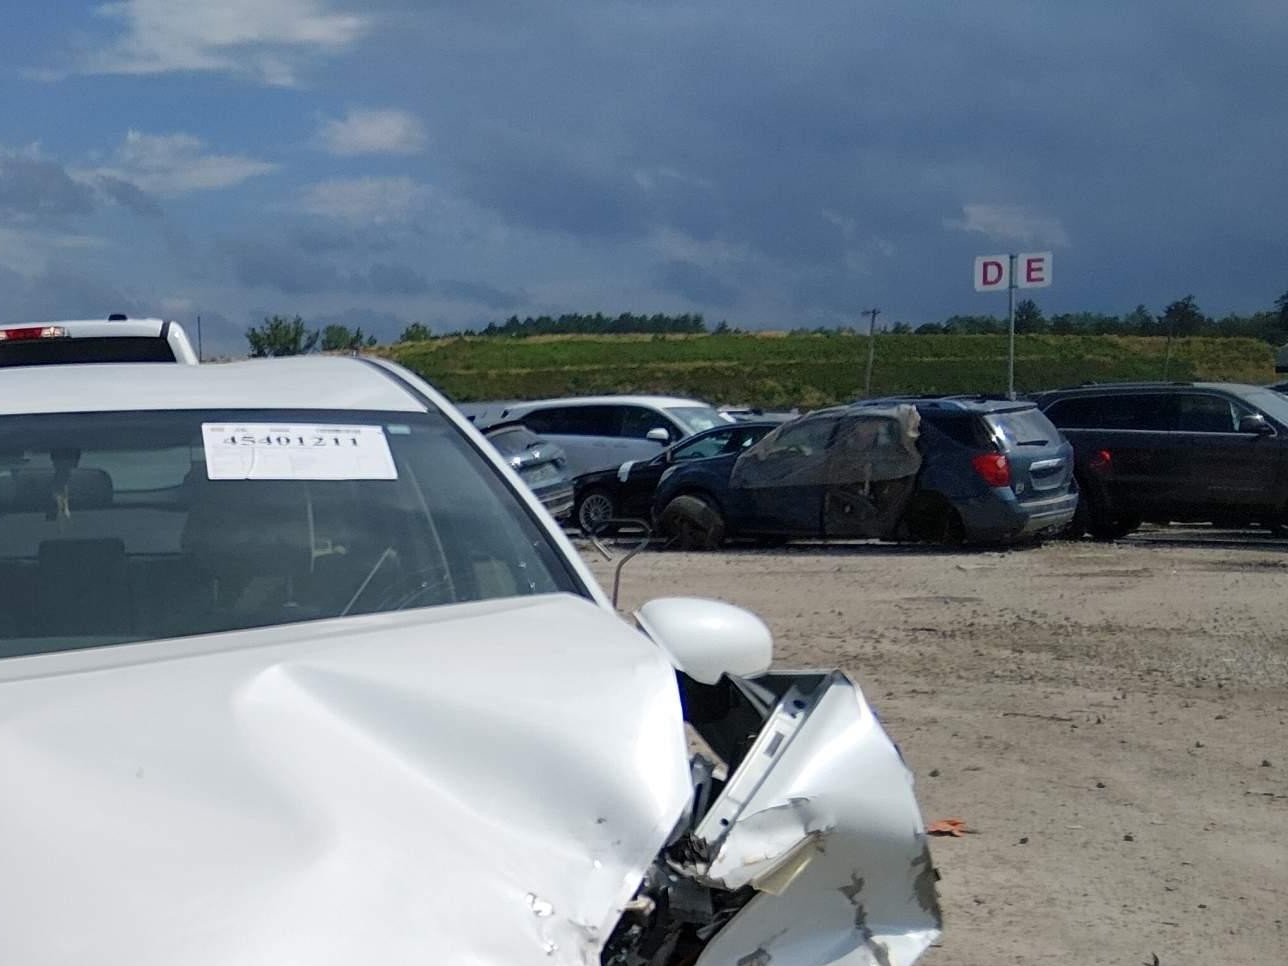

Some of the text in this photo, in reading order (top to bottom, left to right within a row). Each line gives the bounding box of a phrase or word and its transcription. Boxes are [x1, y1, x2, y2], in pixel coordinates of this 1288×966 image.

[982, 257, 1045, 286] D E
[223, 435, 359, 447] 45401211
